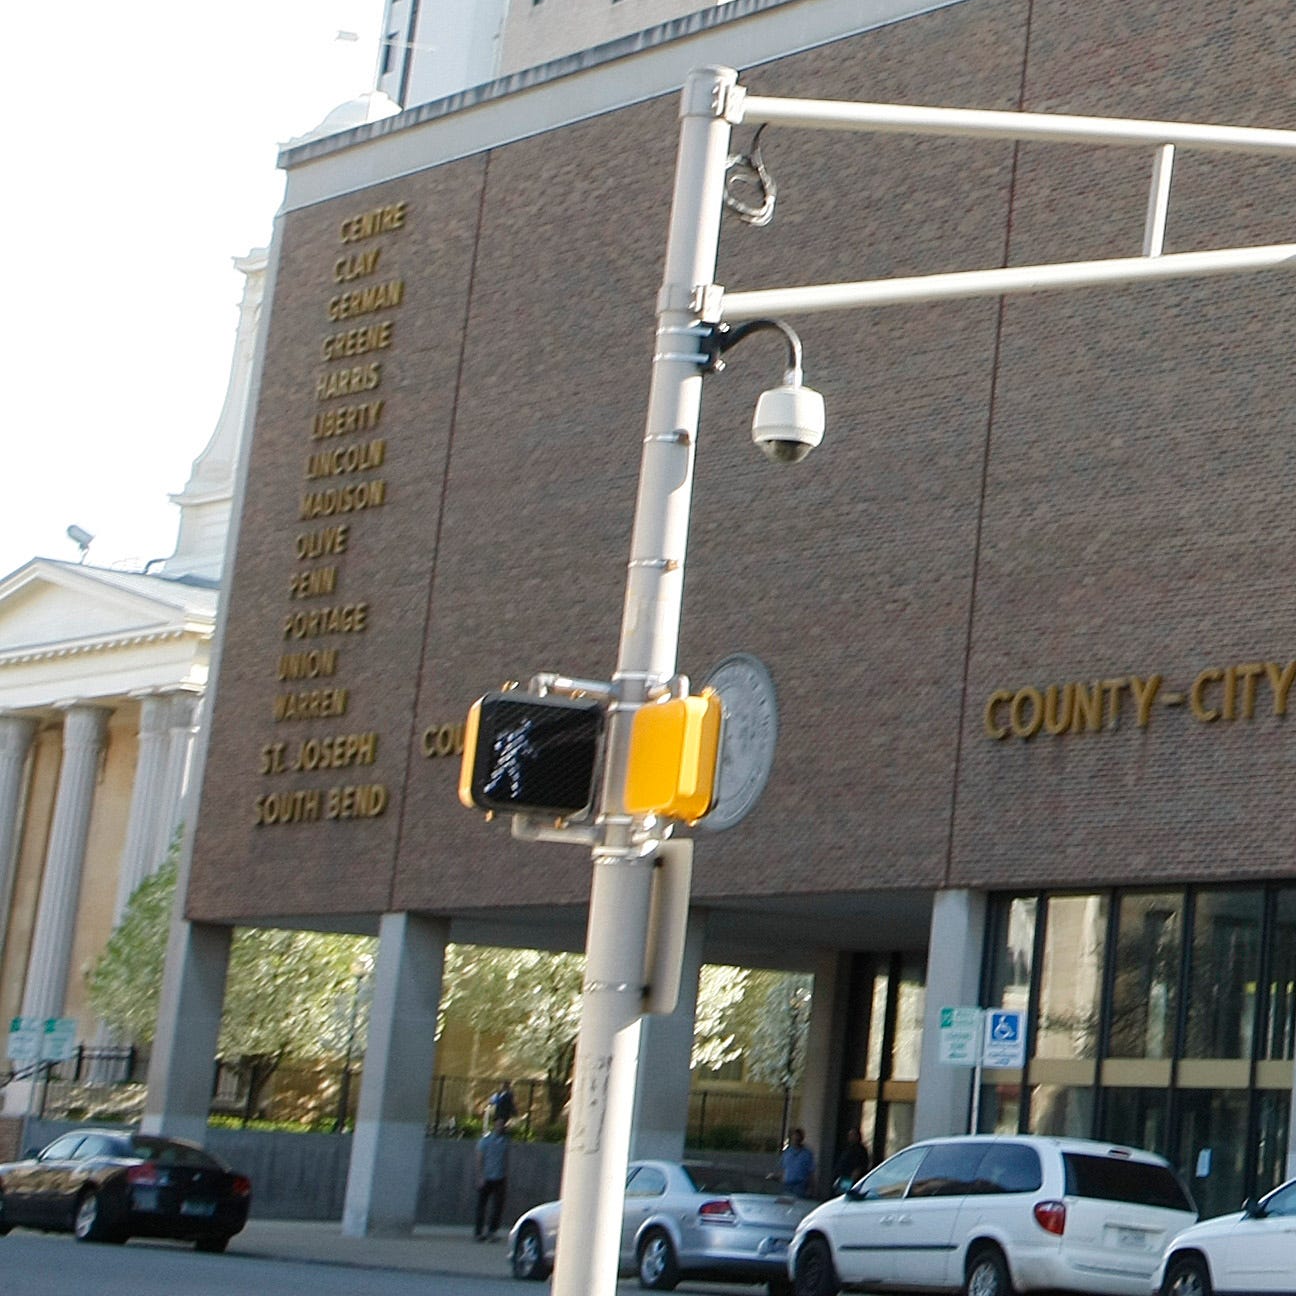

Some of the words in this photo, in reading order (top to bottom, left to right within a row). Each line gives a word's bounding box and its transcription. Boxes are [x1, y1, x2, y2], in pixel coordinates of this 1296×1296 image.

[340, 201, 407, 244] CENTRE
[334, 248, 381, 284] CLAY
[328, 279, 405, 322] GERMAN
[321, 320, 394, 361] GREENE
[316, 362, 381, 401] HARRIS
[311, 400, 384, 440] LIBERTY
[304, 439, 386, 480] LINCOLN
[301, 479, 386, 520] MADISON
[296, 525, 348, 560] OLIVE
[289, 566, 337, 600] PENN
[283, 603, 368, 640] PORTAGE
[279, 649, 337, 681] UNION
[275, 688, 347, 722] WARREN
[293, 731, 377, 771] JOSEPH
[255, 790, 322, 825] SOUTH
[327, 784, 388, 819] BEND
